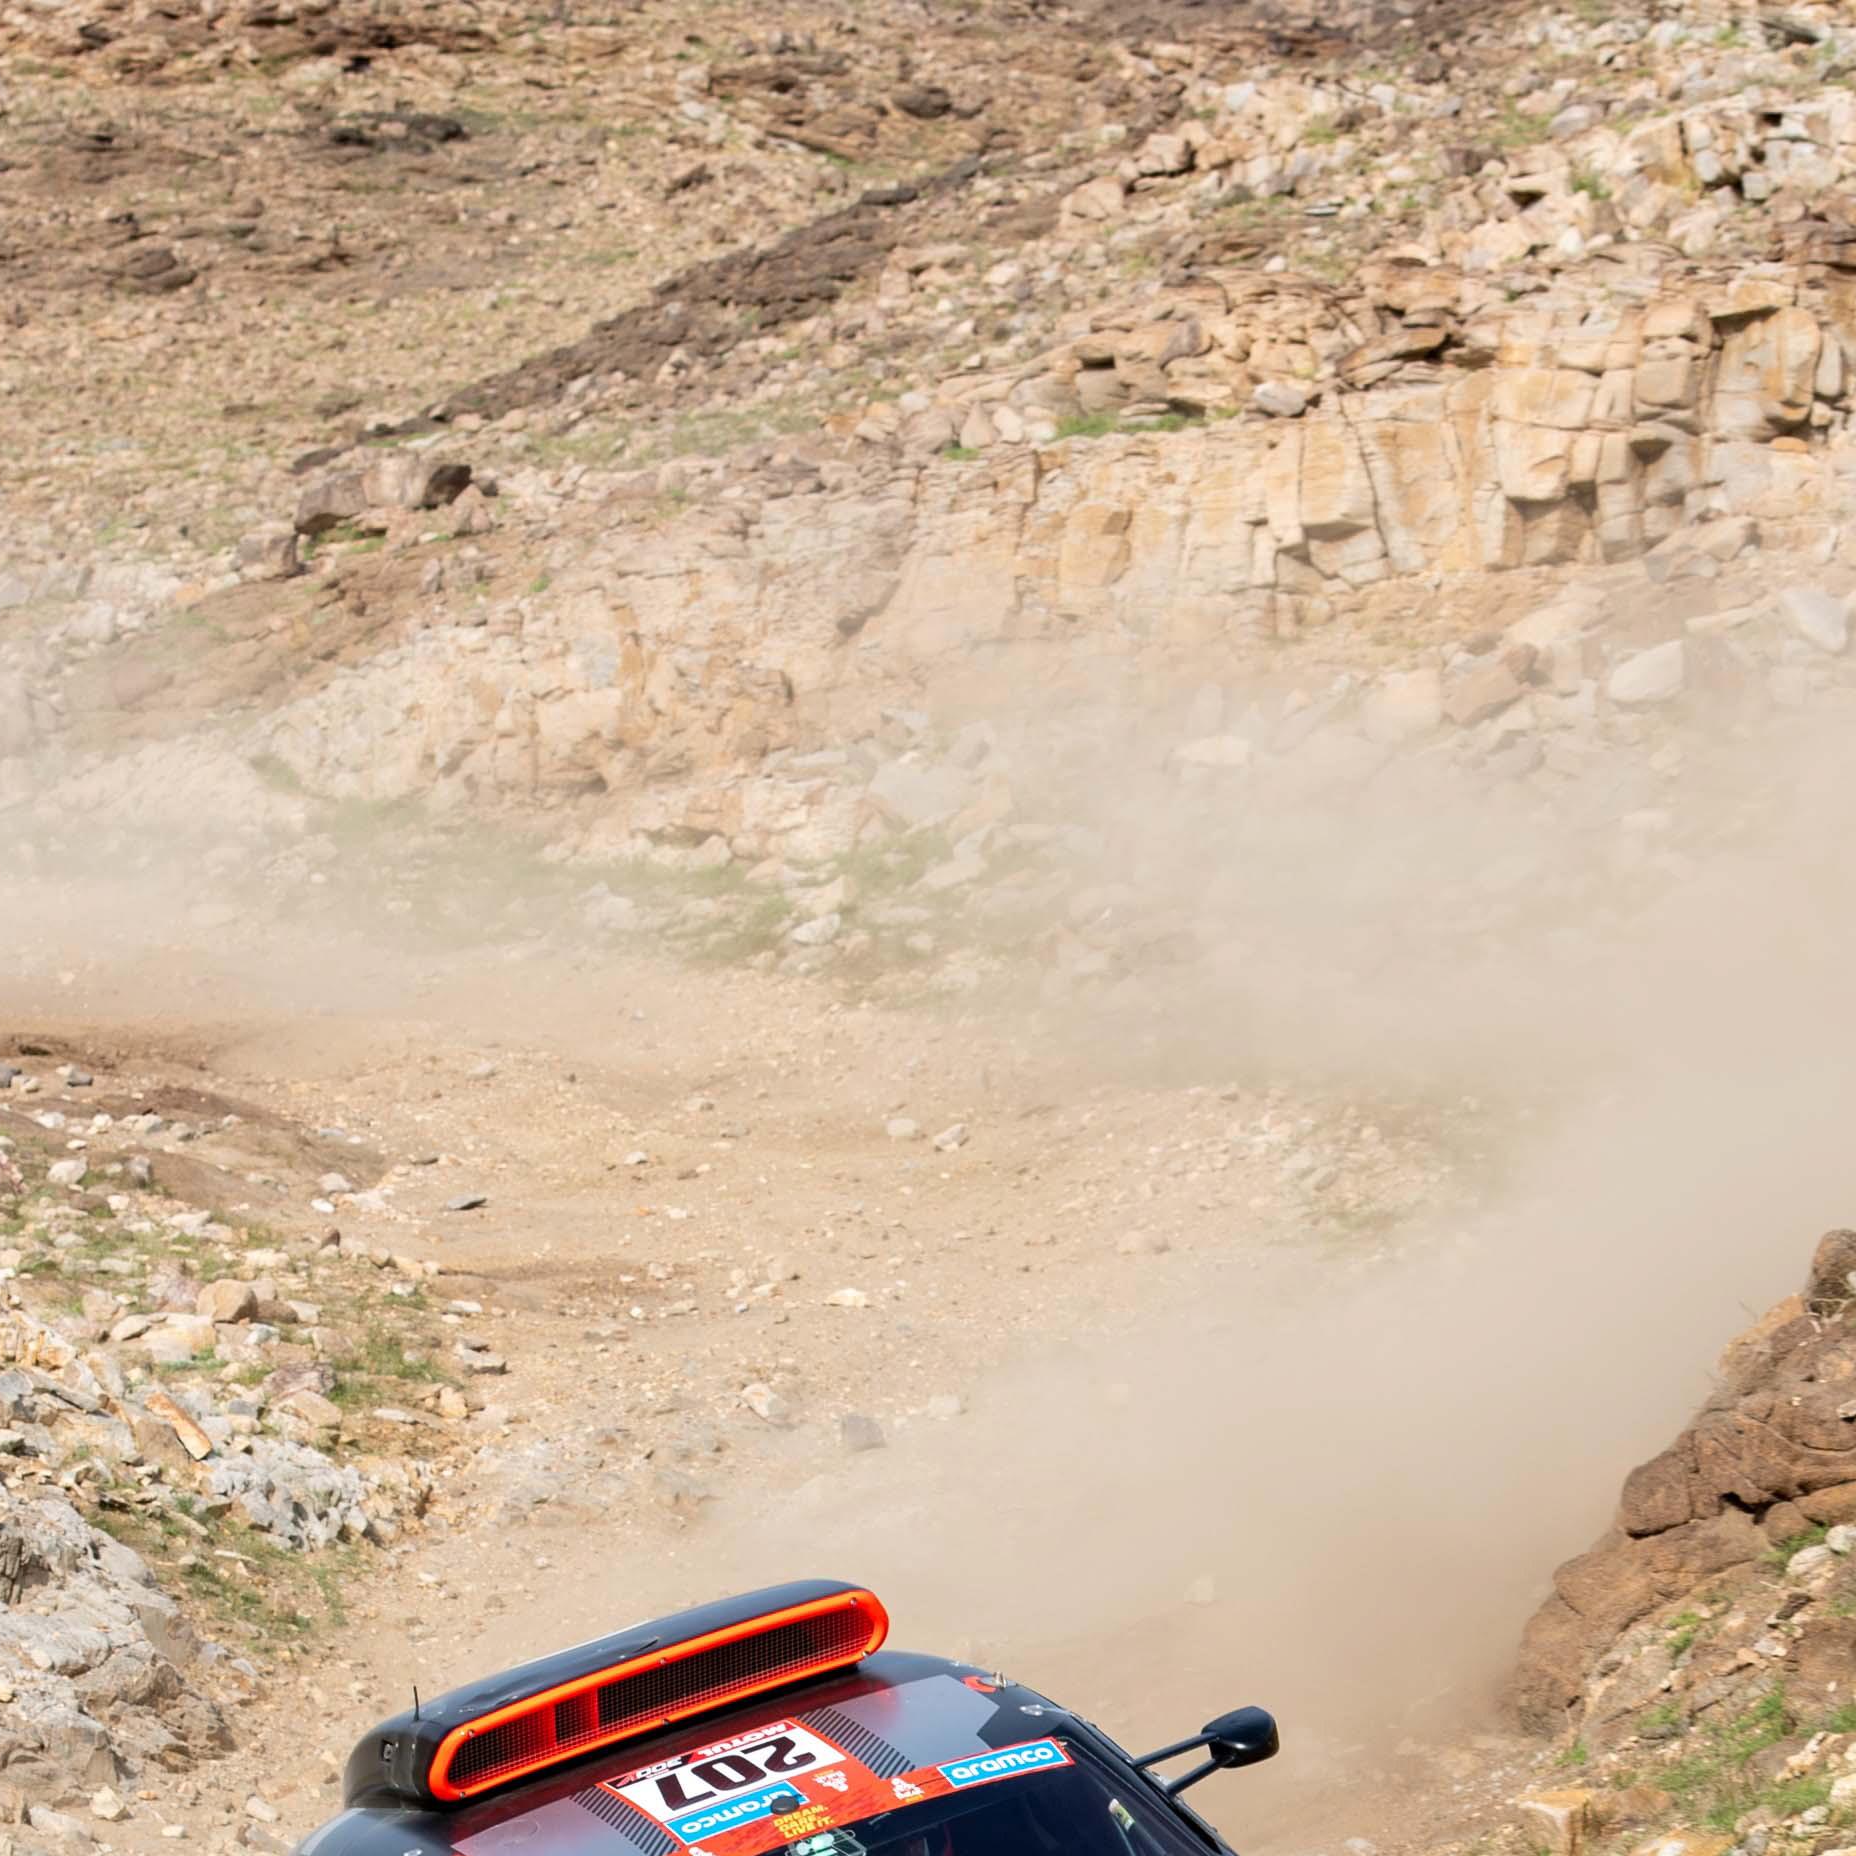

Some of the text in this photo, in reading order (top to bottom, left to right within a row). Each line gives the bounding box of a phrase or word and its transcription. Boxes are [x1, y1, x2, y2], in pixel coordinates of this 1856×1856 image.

[697, 1723, 788, 1759] MOTUL
[655, 1735, 817, 1811] 207
[951, 1746, 1054, 1780] aramco
[773, 1804, 829, 1827] DREAM.
[784, 1822, 816, 1839] LIVE
